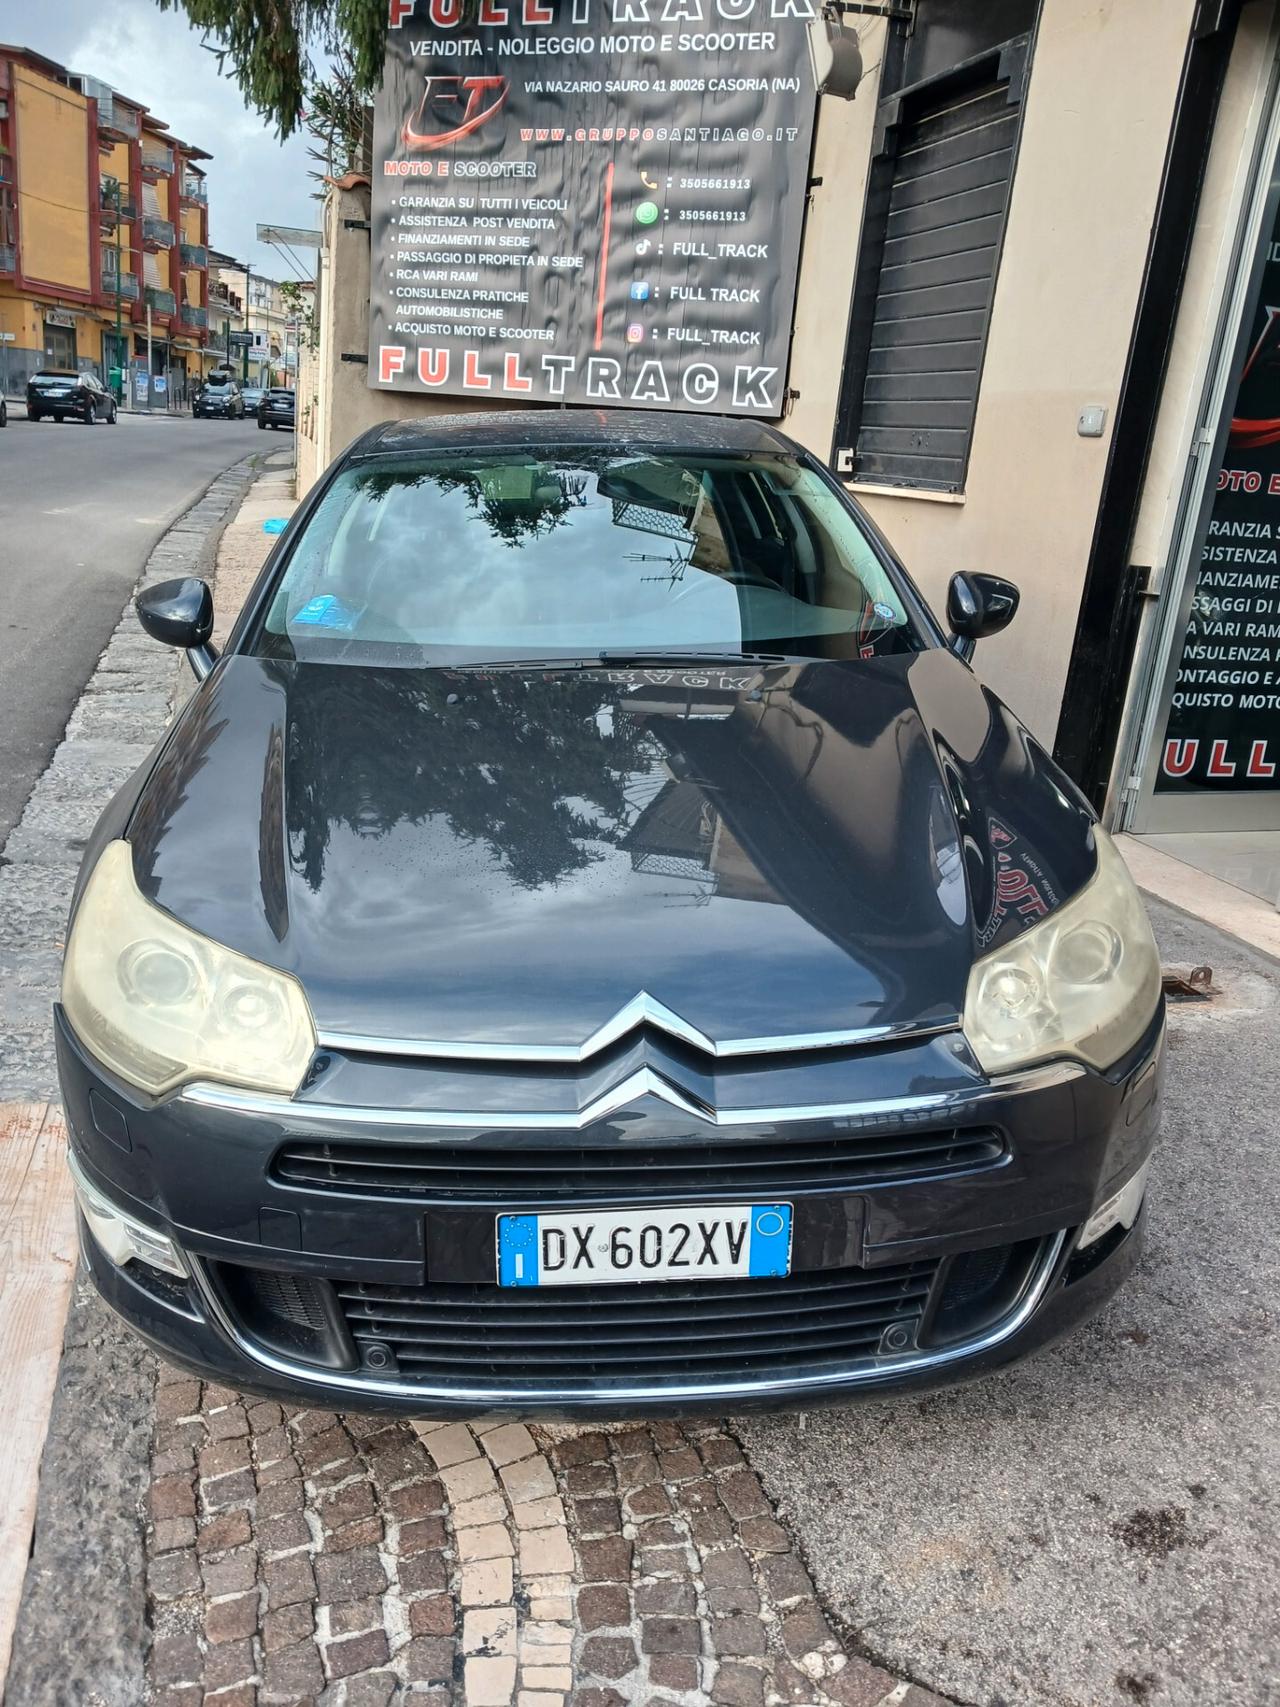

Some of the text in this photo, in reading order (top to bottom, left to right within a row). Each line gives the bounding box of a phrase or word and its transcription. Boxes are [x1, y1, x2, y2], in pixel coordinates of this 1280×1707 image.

[409, 38, 483, 57] VENDITA
[498, 36, 595, 56] NOLEGGIO
[600, 34, 655, 53] MOTO
[660, 34, 673, 51] E
[677, 31, 776, 51] SCOOTER
[524, 77, 801, 94] VIA NAZARIO SAURO 41 80026 CASORIA (NA)
[519, 127, 799, 143] WWW.GRUPPOSANTIAGO.IT
[383, 160, 537, 178] MOTO E SCOOTER
[679, 178, 751, 190] 3505661913
[399, 197, 456, 209] GARANZIA
[458, 197, 474, 209] SU
[480, 198, 512, 210] TUTTI
[521, 199, 568, 211] VEICOLI
[399, 215, 555, 229] ASSISTENZA POST VENDITA
[679, 210, 746, 221] 3505661913
[398, 234, 530, 248] FINANZIAMENTI IN SEDE
[672, 242, 769, 260] FULL_TRACK
[397, 251, 583, 268] PASSAGGIO DI PROPIETA IN SEDE
[396, 269, 478, 282] RCA VARI RAMI
[396, 287, 529, 303] CONSULENZA PRATICHE
[710, 287, 760, 303] TRACK
[395, 305, 504, 320] AUTOMOBILISTICHE
[395, 323, 554, 340] ACQUISTO MOTO E SCOOTER
[667, 327, 760, 346] FULL_TRACK
[1208, 520, 1271, 539] RANZIA
[1255, 599, 1273, 614] DI
[1202, 621, 1241, 637] VARI
[1183, 645, 1271, 662] NSULENZA
[1263, 671, 1274, 685] E
[1171, 692, 1234, 709] QUISTO
